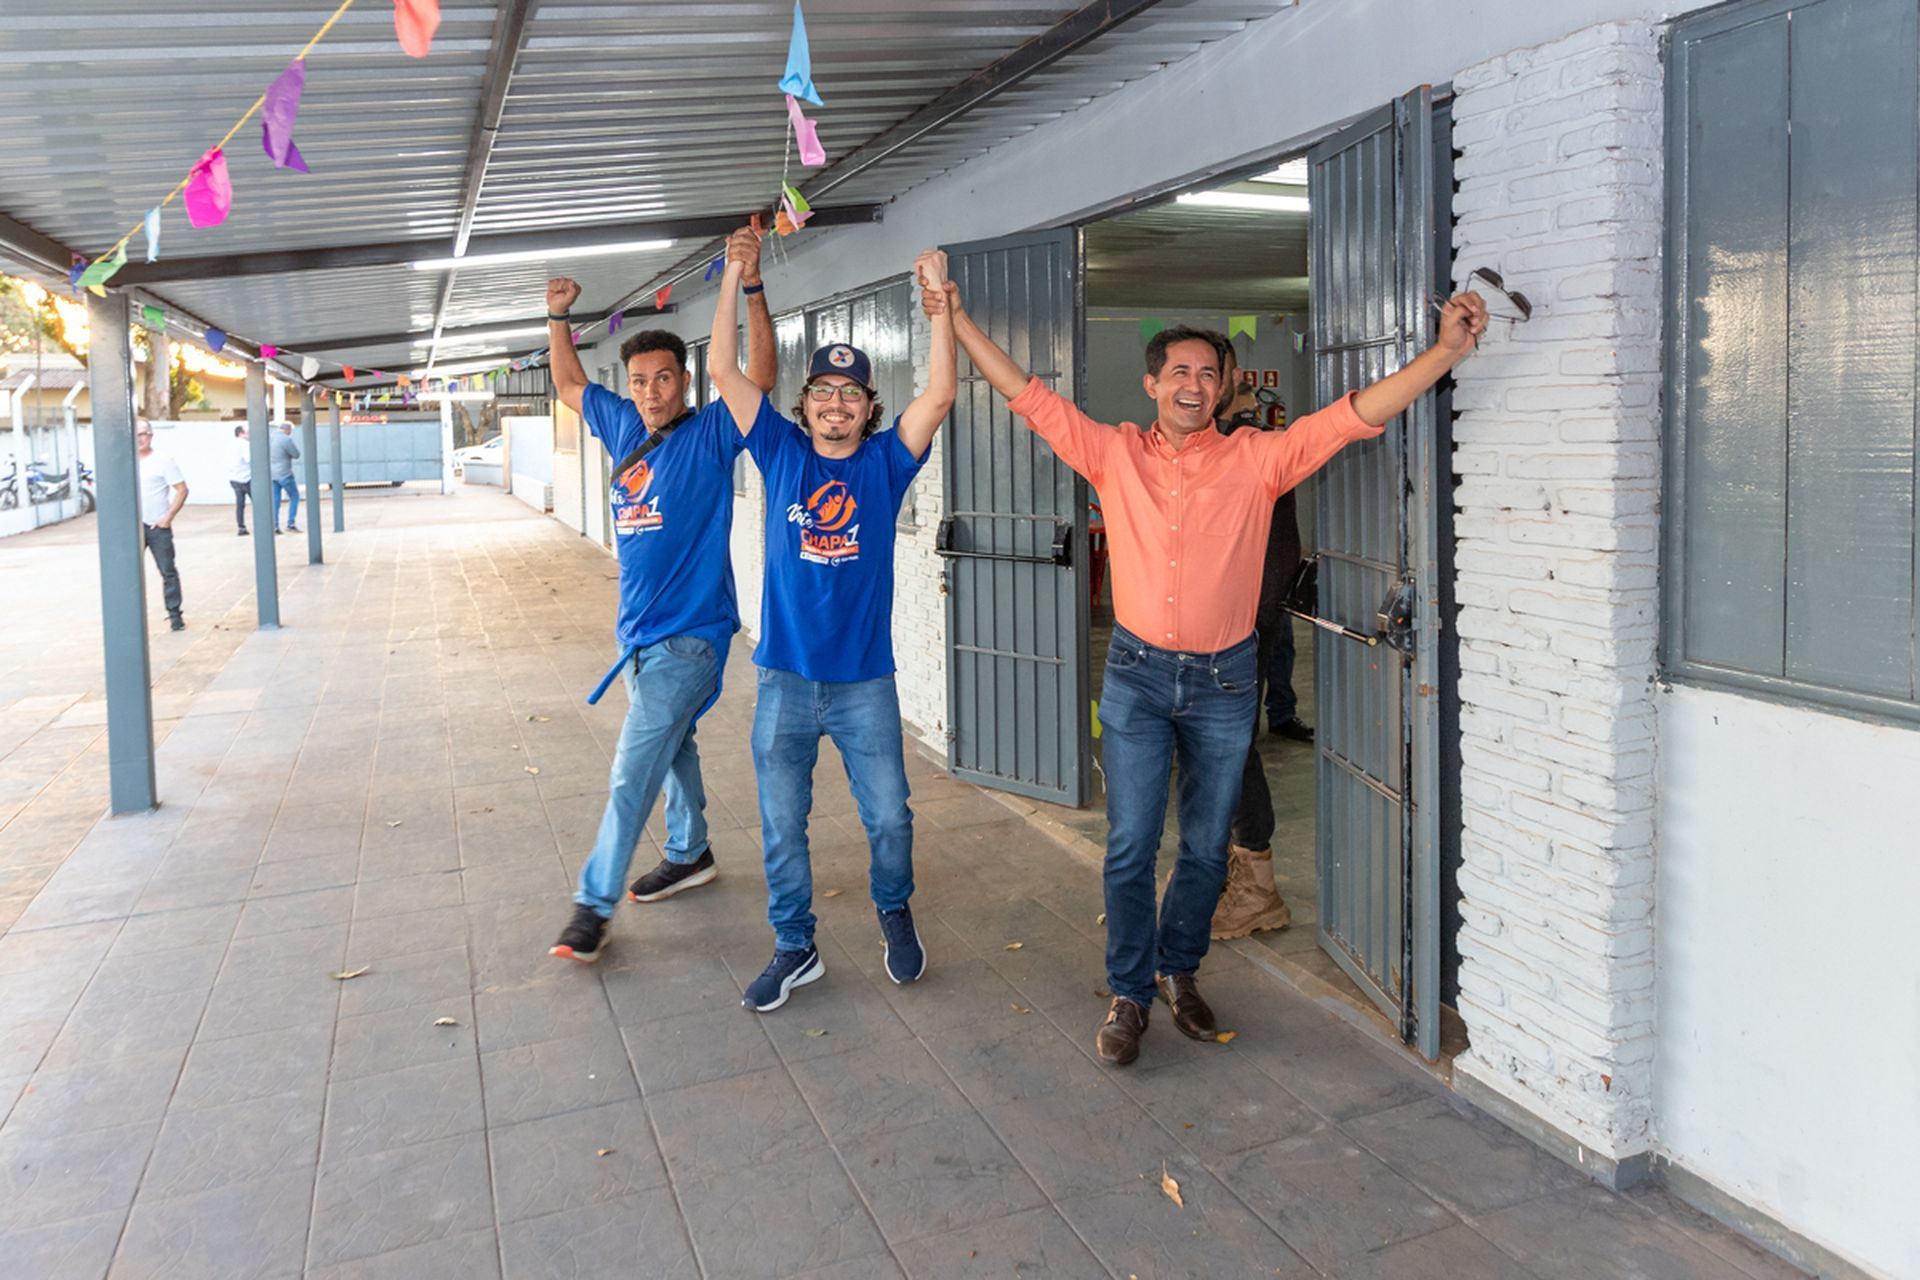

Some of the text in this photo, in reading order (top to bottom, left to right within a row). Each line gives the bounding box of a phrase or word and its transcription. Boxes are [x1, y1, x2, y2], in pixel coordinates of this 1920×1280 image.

[647, 495, 662, 518] 1
[786, 503, 815, 529] Vote
[801, 529, 848, 550] CHAPA
[845, 523, 860, 547] 1
